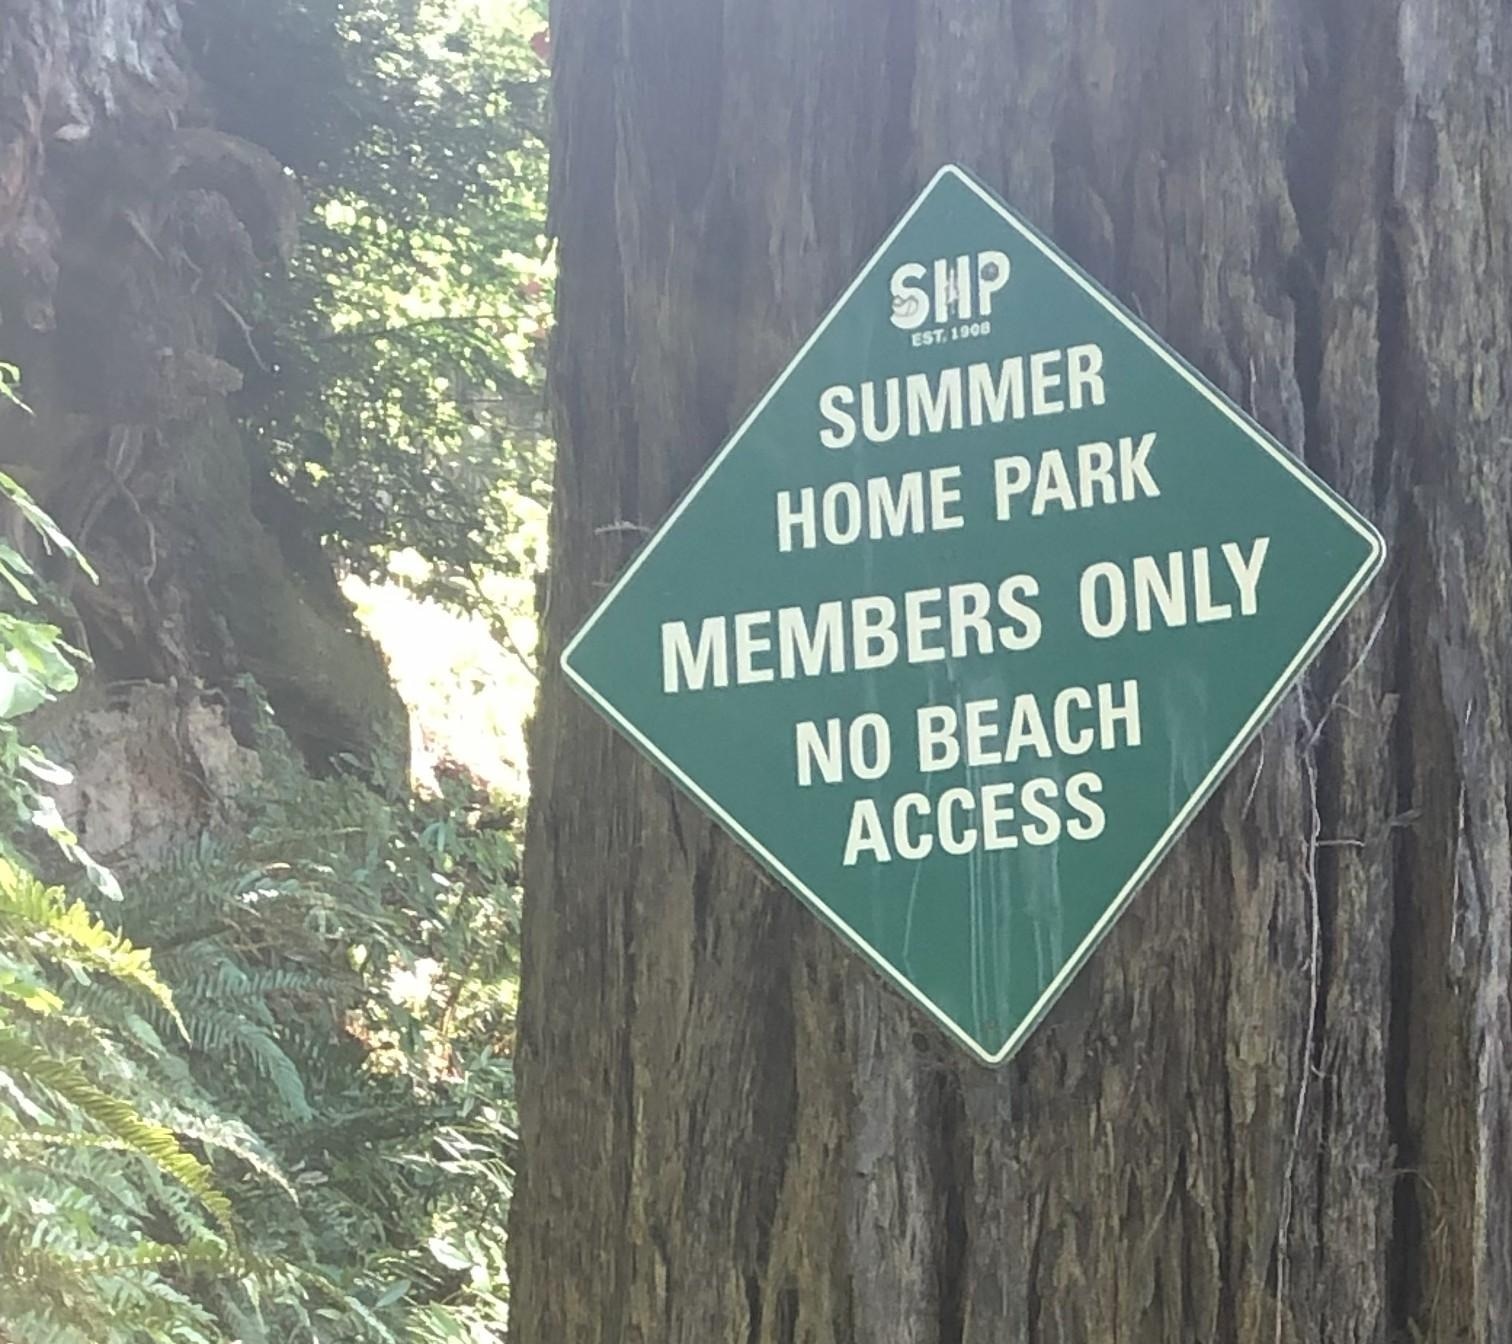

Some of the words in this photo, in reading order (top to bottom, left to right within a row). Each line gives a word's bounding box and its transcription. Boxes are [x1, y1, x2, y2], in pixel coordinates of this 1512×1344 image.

[818, 343, 1106, 447] SUMMER
[776, 467, 964, 551] HOME
[994, 433, 1160, 520] PARK
[660, 575, 1041, 692] MEMBERS
[1080, 538, 1269, 639] ONLY
[795, 711, 890, 786] NO
[917, 680, 1141, 773] BEACH
[842, 773, 1105, 865] ACCESS
